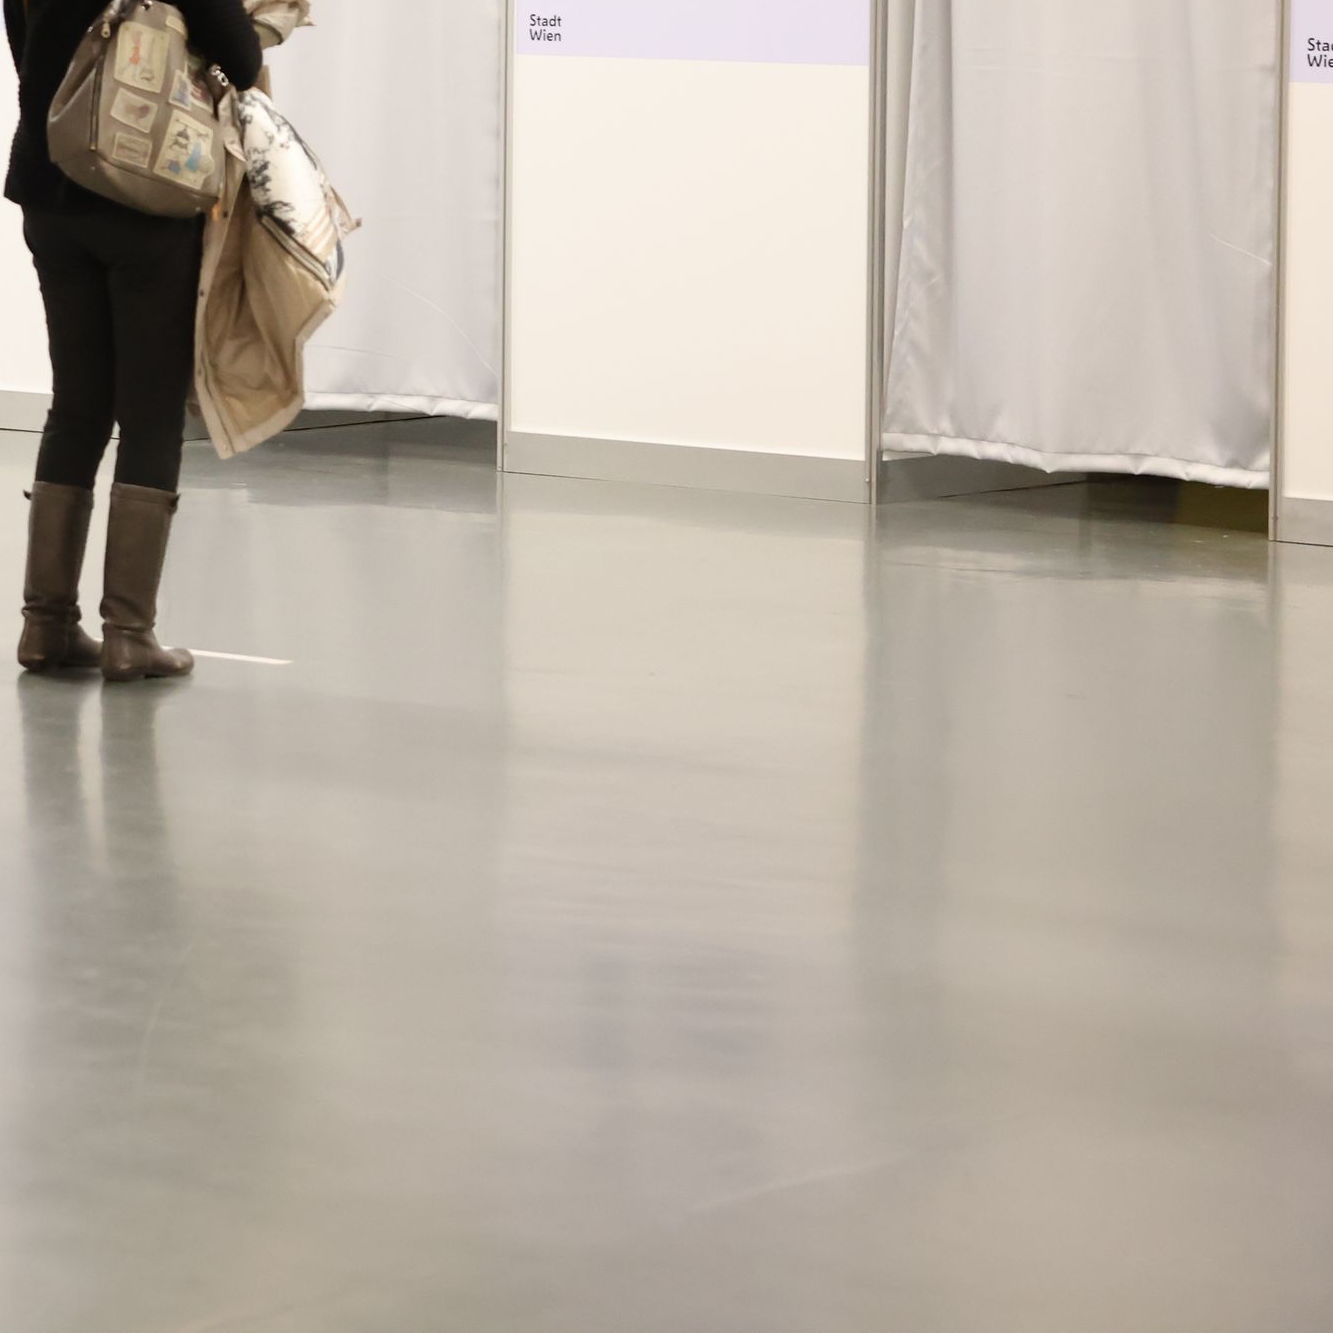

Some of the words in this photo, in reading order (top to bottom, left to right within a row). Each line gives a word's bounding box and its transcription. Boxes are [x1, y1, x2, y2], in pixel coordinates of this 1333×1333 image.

[529, 13, 562, 27] Stadt
[529, 28, 562, 42] Wien
[1307, 37, 1333, 52] Sta
